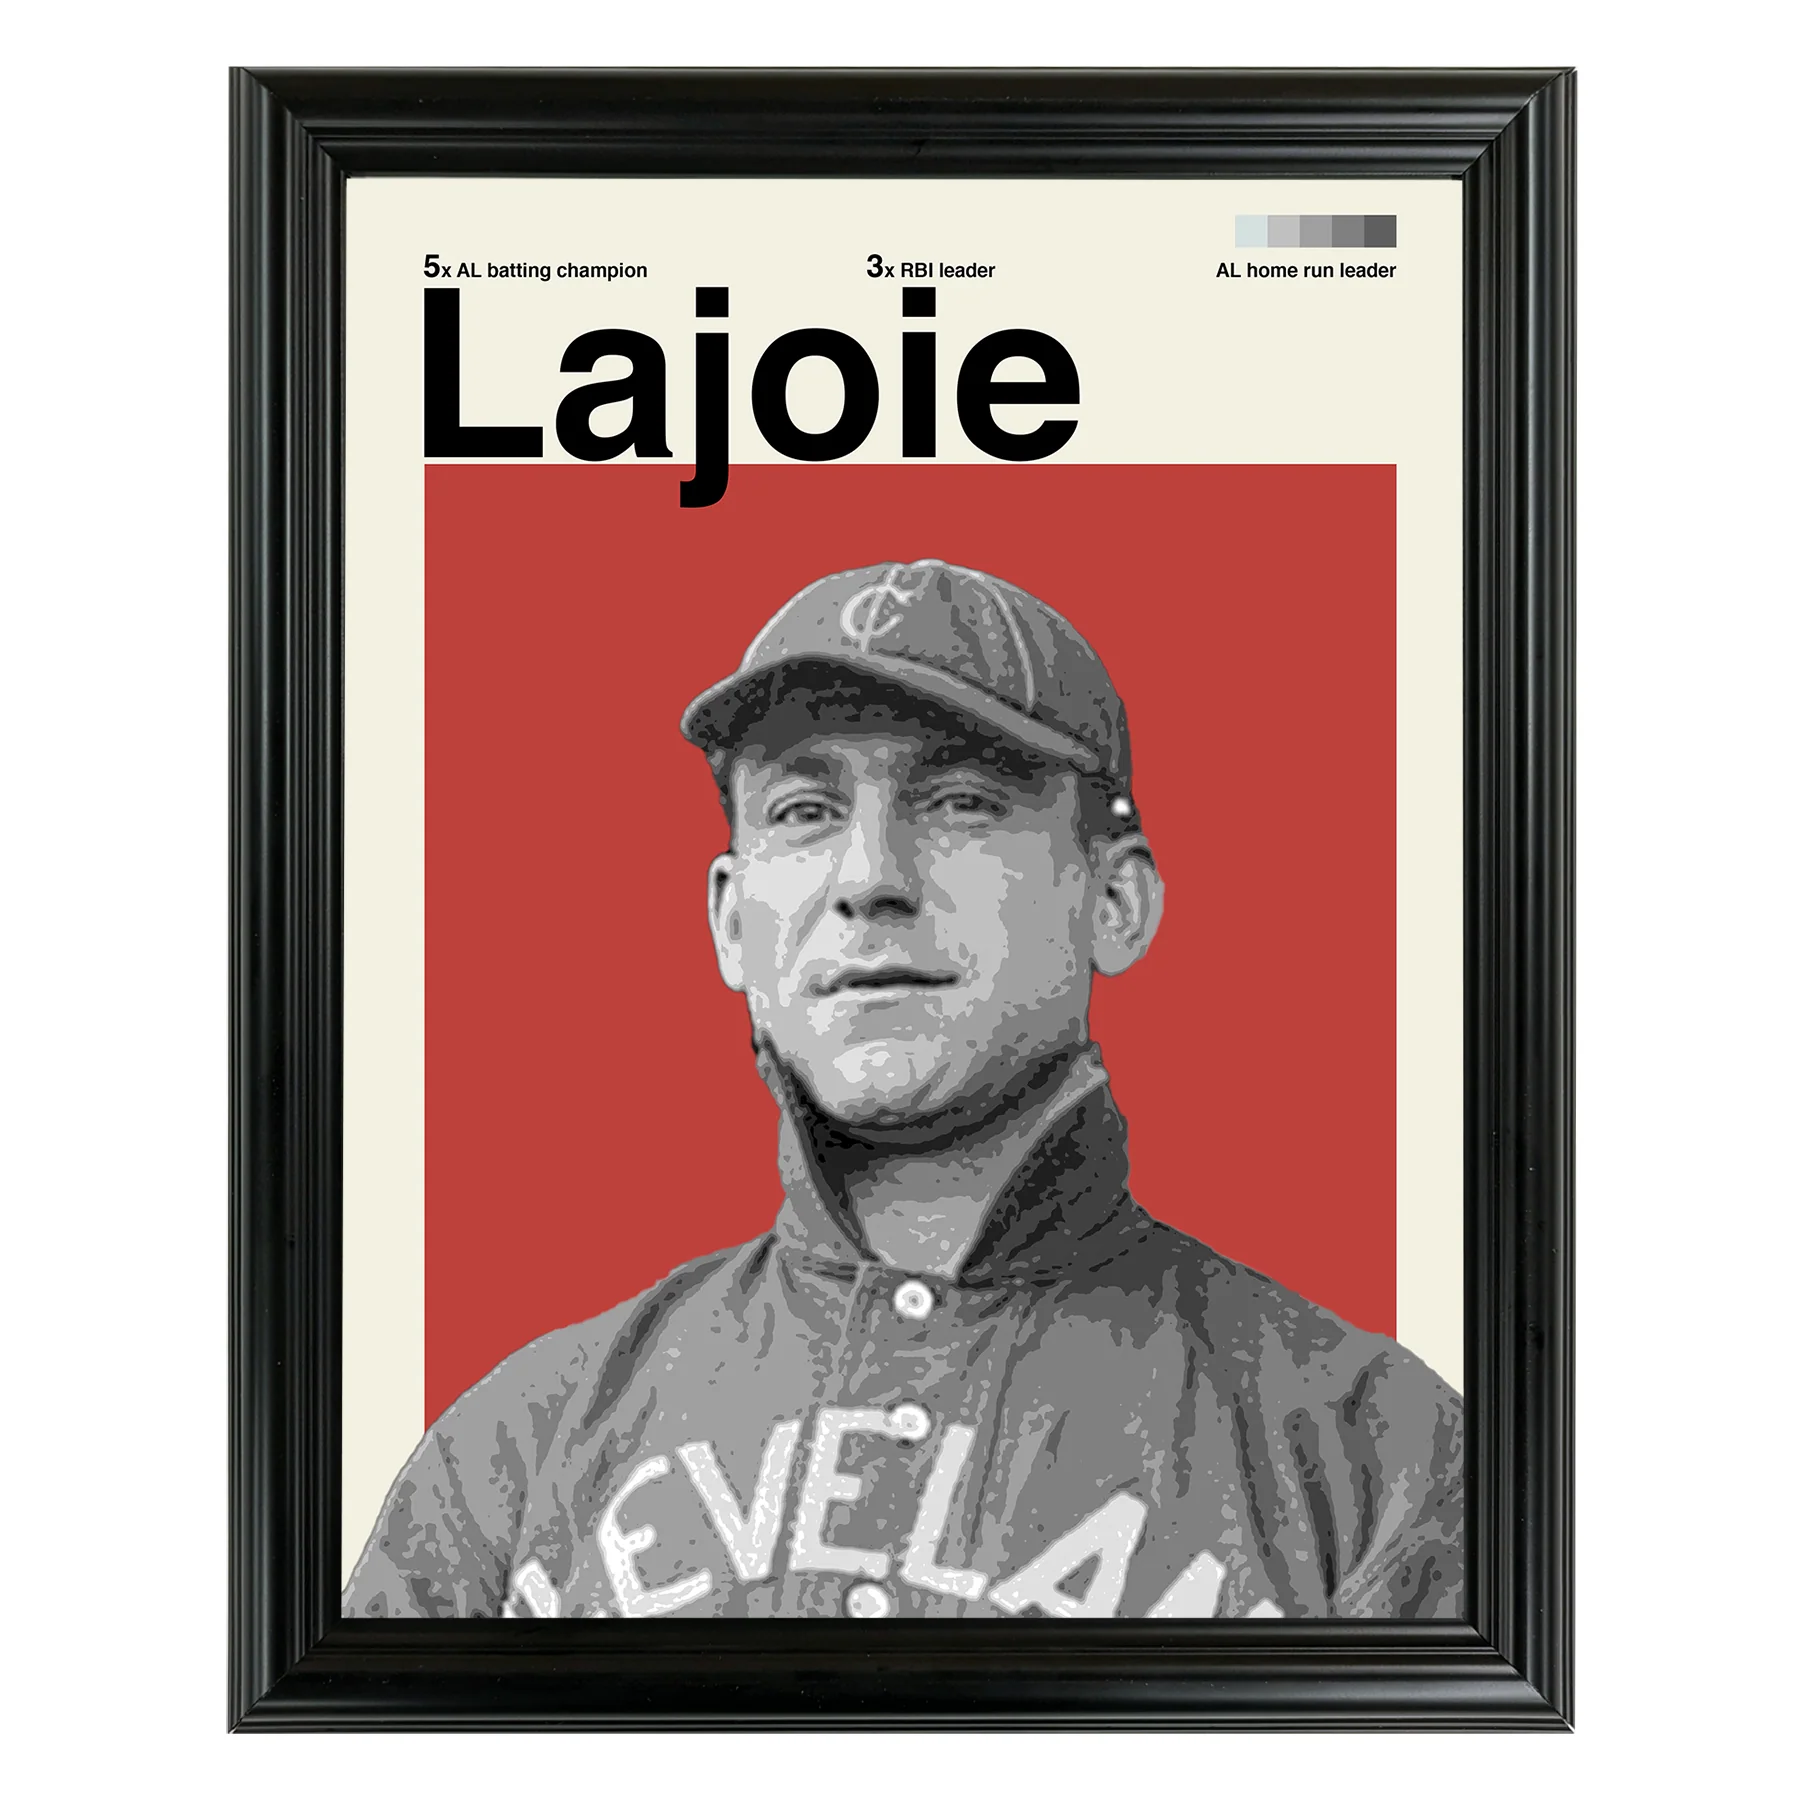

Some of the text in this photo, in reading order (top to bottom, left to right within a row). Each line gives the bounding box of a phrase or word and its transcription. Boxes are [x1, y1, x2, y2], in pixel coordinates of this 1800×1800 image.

[423, 254, 648, 282] 5x AL batting champion
[866, 253, 996, 278] 3x RBI leader
[1215, 262, 1397, 278] AL home run leader
[424, 287, 1080, 508] Lajoie
